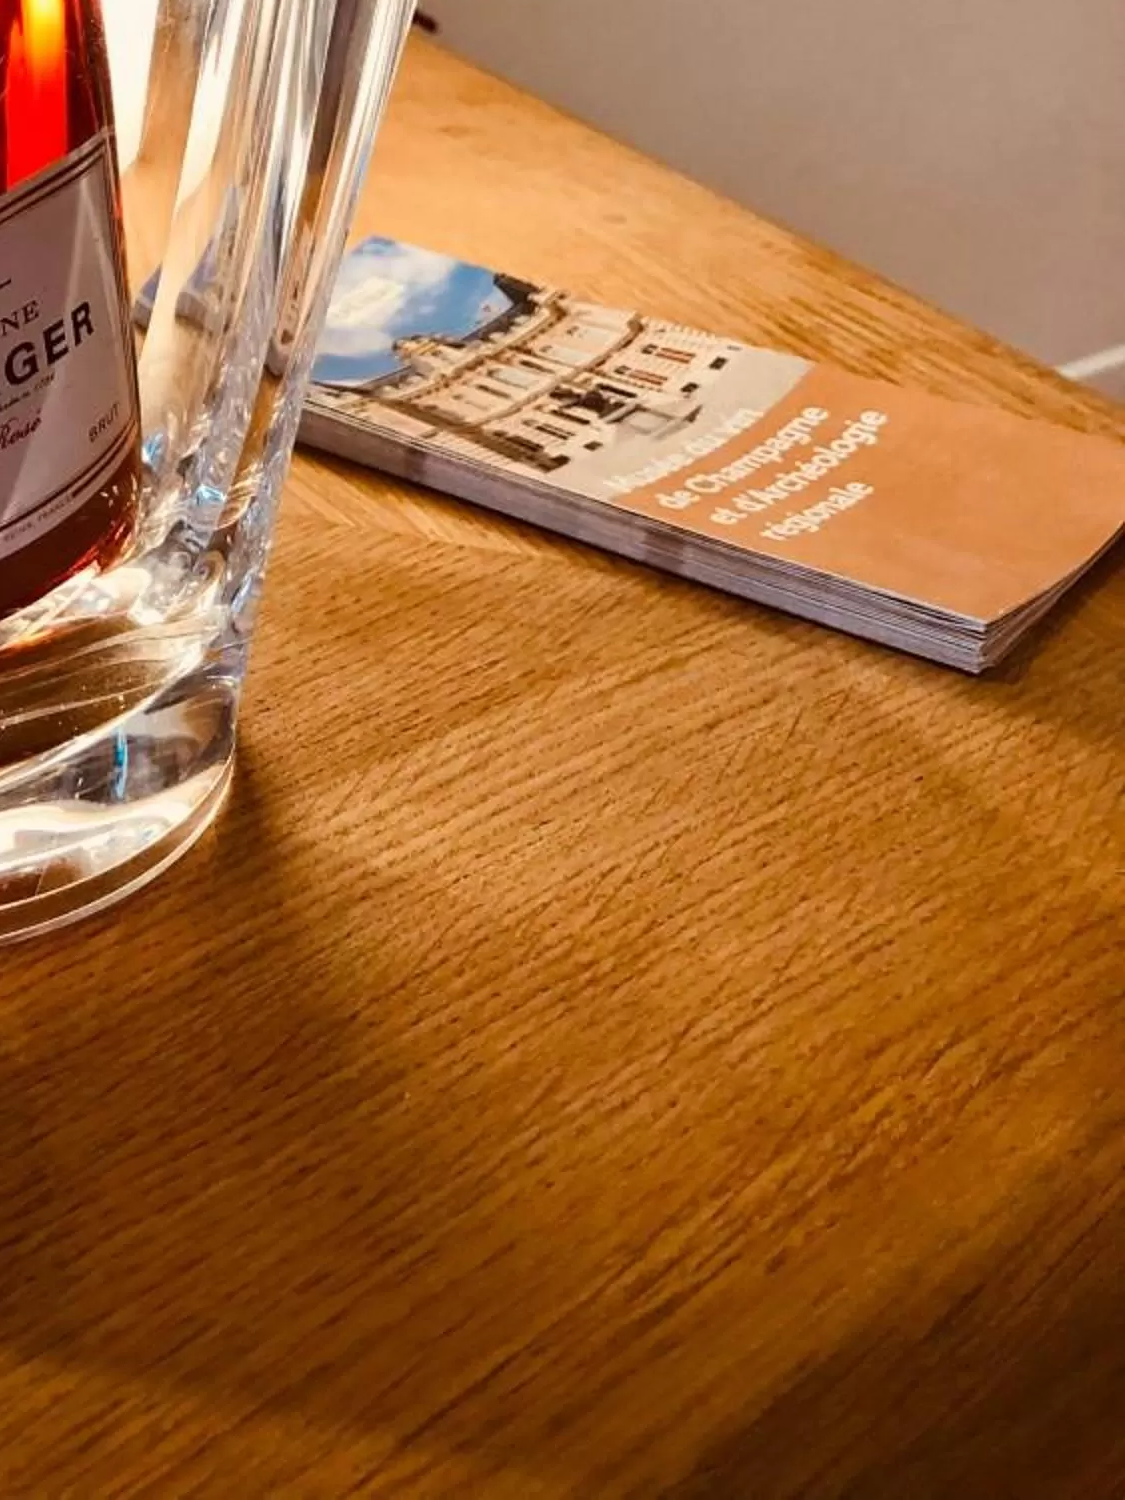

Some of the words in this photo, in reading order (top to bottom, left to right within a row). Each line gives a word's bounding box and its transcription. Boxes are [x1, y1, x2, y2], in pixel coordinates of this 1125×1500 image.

[88, 402, 119, 442] BRUT
[656, 490, 700, 509] de
[684, 406, 829, 493] Champagne
[709, 506, 747, 526] et
[759, 481, 874, 541] régionale
